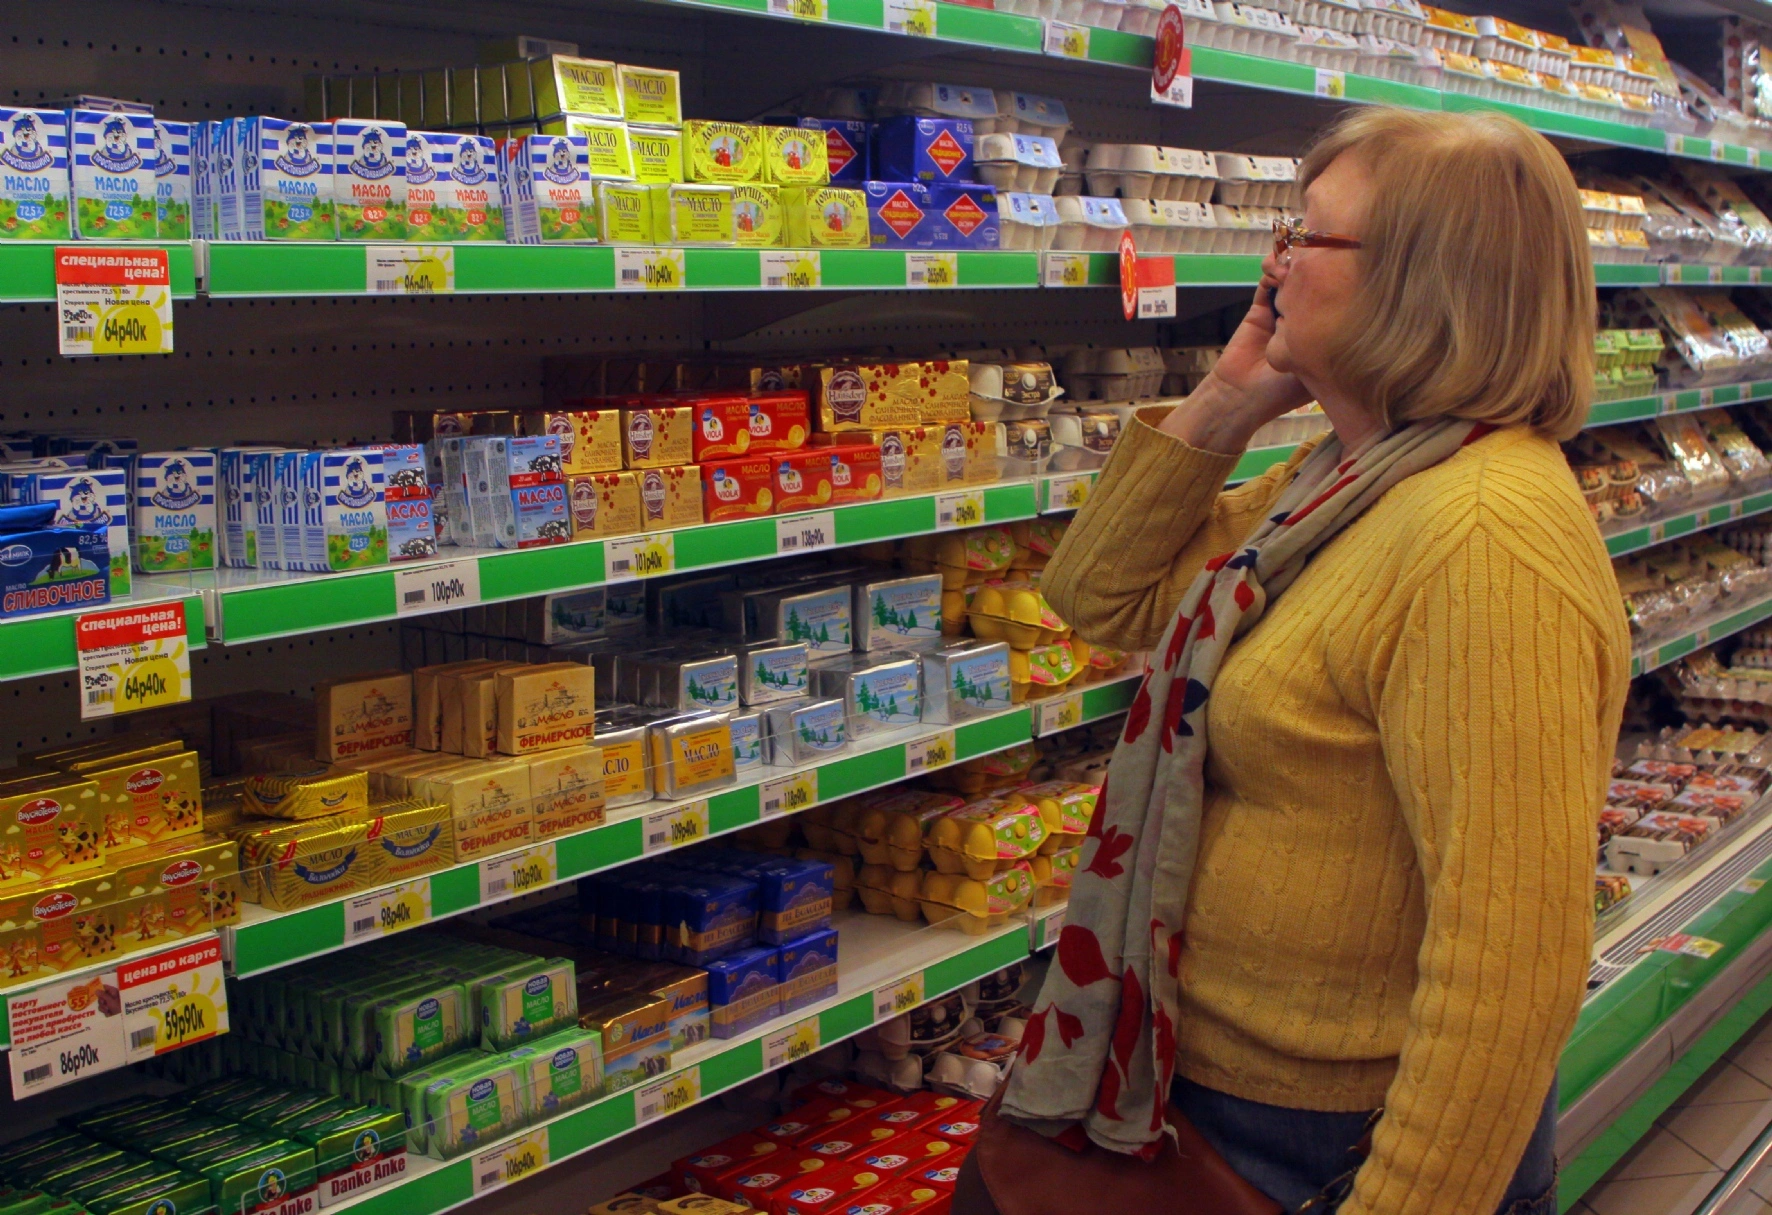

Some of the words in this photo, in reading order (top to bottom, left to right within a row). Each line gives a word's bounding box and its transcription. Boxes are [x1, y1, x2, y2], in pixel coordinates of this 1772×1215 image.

[571, 68, 605, 86] МАСЛО
[634, 79, 666, 95] МАСЛО
[637, 141, 670, 157] МАСЛО
[4, 175, 50, 192] МАСЛО
[94, 176, 139, 192] МАСЛО
[278, 180, 318, 196] МАСЛО
[352, 184, 391, 198] МАСЛО
[408, 188, 436, 202] АСЛО
[455, 189, 489, 202] МАСЛО
[549, 188, 582, 201] МАСЛО
[614, 196, 641, 212] МАСЛО
[688, 196, 722, 212] МАСЛО
[61, 254, 158, 269] специальная
[125, 266, 164, 280] цена!
[645, 265, 673, 287] 101р40к
[104, 297, 128, 306] Новая
[129, 299, 150, 308] цена
[104, 318, 147, 347] 64р40к
[776, 401, 806, 411] МАСЛО
[741, 464, 770, 474] МАСЛО
[518, 486, 563, 505] МАСЛО
[718, 489, 739, 499] VIOLA
[340, 511, 374, 526] МАСЛО
[386, 501, 429, 520] АСЛО
[155, 513, 197, 528] МАСЛО
[78, 535, 98, 546] 82,5
[635, 550, 663, 574] 101р40к
[4, 578, 105, 612] СЛИВОЧНОЕ
[431, 578, 465, 604] 100р90к
[81, 608, 175, 632] специальная
[142, 617, 182, 636] цена!
[124, 655, 148, 666] Новая
[149, 651, 169, 663] цена
[125, 672, 167, 703] 64р40к
[537, 709, 574, 726] МАСЛО
[337, 730, 411, 755] ФЕРМЕРСКОЕ
[520, 724, 592, 748] ФЕРМЕРСКОЕ
[684, 742, 720, 763] МАСЛО
[539, 808, 602, 834] ФЕРМЕРСКОЕ
[461, 823, 529, 852] ФЕРМЕРСКОЕ
[512, 863, 543, 889] 103р90к
[381, 901, 410, 929] 98р40к
[123, 964, 157, 983] цена
[159, 959, 176, 972] по
[179, 947, 217, 966] карте
[11, 997, 38, 1011] Карту
[12, 999, 67, 1018] постоянного
[70, 994, 88, 1008] 55
[526, 995, 549, 1009] МАСЛО
[12, 1009, 64, 1028] покупателя
[13, 1024, 44, 1036] можно
[45, 1009, 96, 1030] приобрести
[165, 1001, 205, 1043] 59р90к
[417, 1019, 439, 1033] МАСЛО
[14, 1037, 25, 1045] на
[27, 1028, 56, 1043] любой
[58, 1021, 82, 1034] кассе
[630, 1021, 666, 1043] Масло
[60, 1044, 99, 1076] 86р90к
[555, 1069, 577, 1082] МАСЛО
[662, 1085, 689, 1111] 107р90к
[472, 1100, 496, 1115] МАСЛО
[505, 1151, 536, 1178] 106р40к
[331, 1169, 371, 1198] Danke
[374, 1157, 406, 1180] Anke
[280, 1196, 312, 1215] Anke
[811, 1190, 834, 1203] VIOLA
